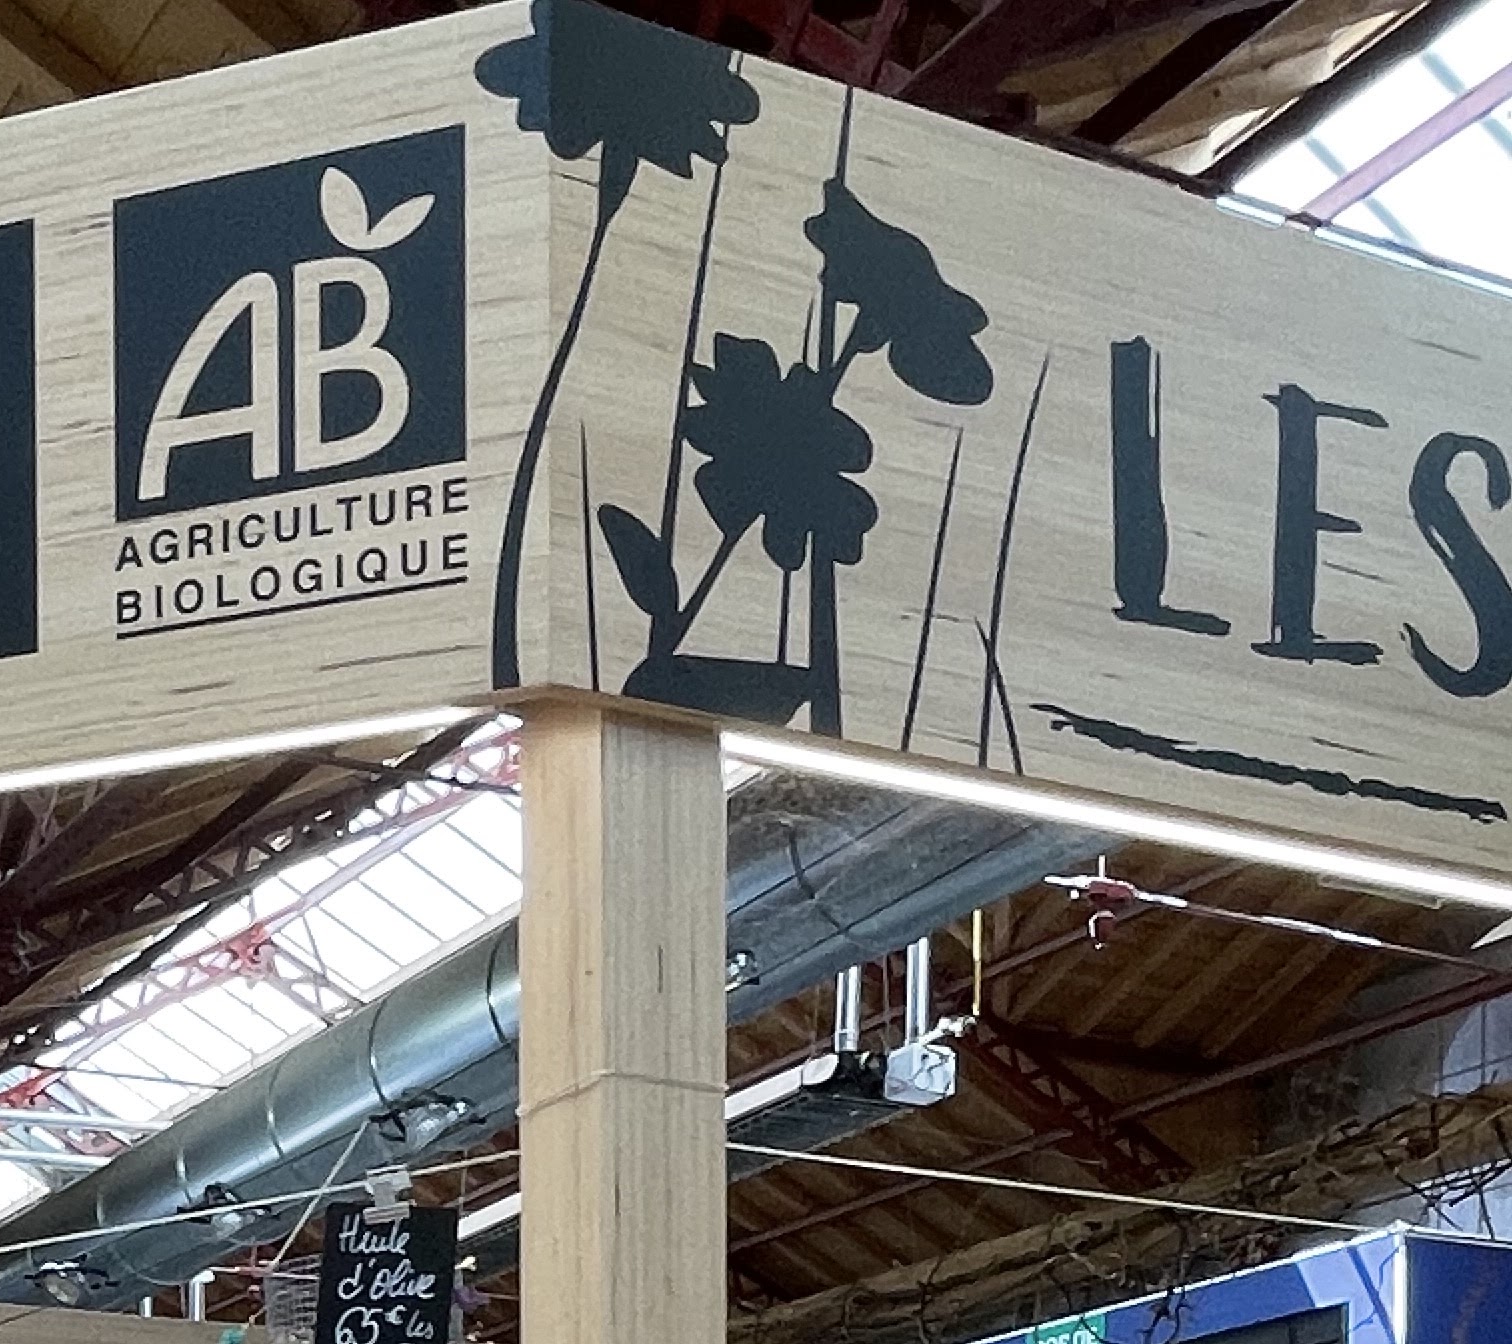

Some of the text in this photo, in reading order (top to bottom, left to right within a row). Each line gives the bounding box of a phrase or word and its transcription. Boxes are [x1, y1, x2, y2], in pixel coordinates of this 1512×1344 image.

[137, 256, 410, 501] AB
[115, 476, 469, 572] AGRICULTURE
[1109, 335, 1512, 699] LES
[116, 534, 469, 624] BIOLOGIQUE
[338, 1212, 410, 1255] Huile
